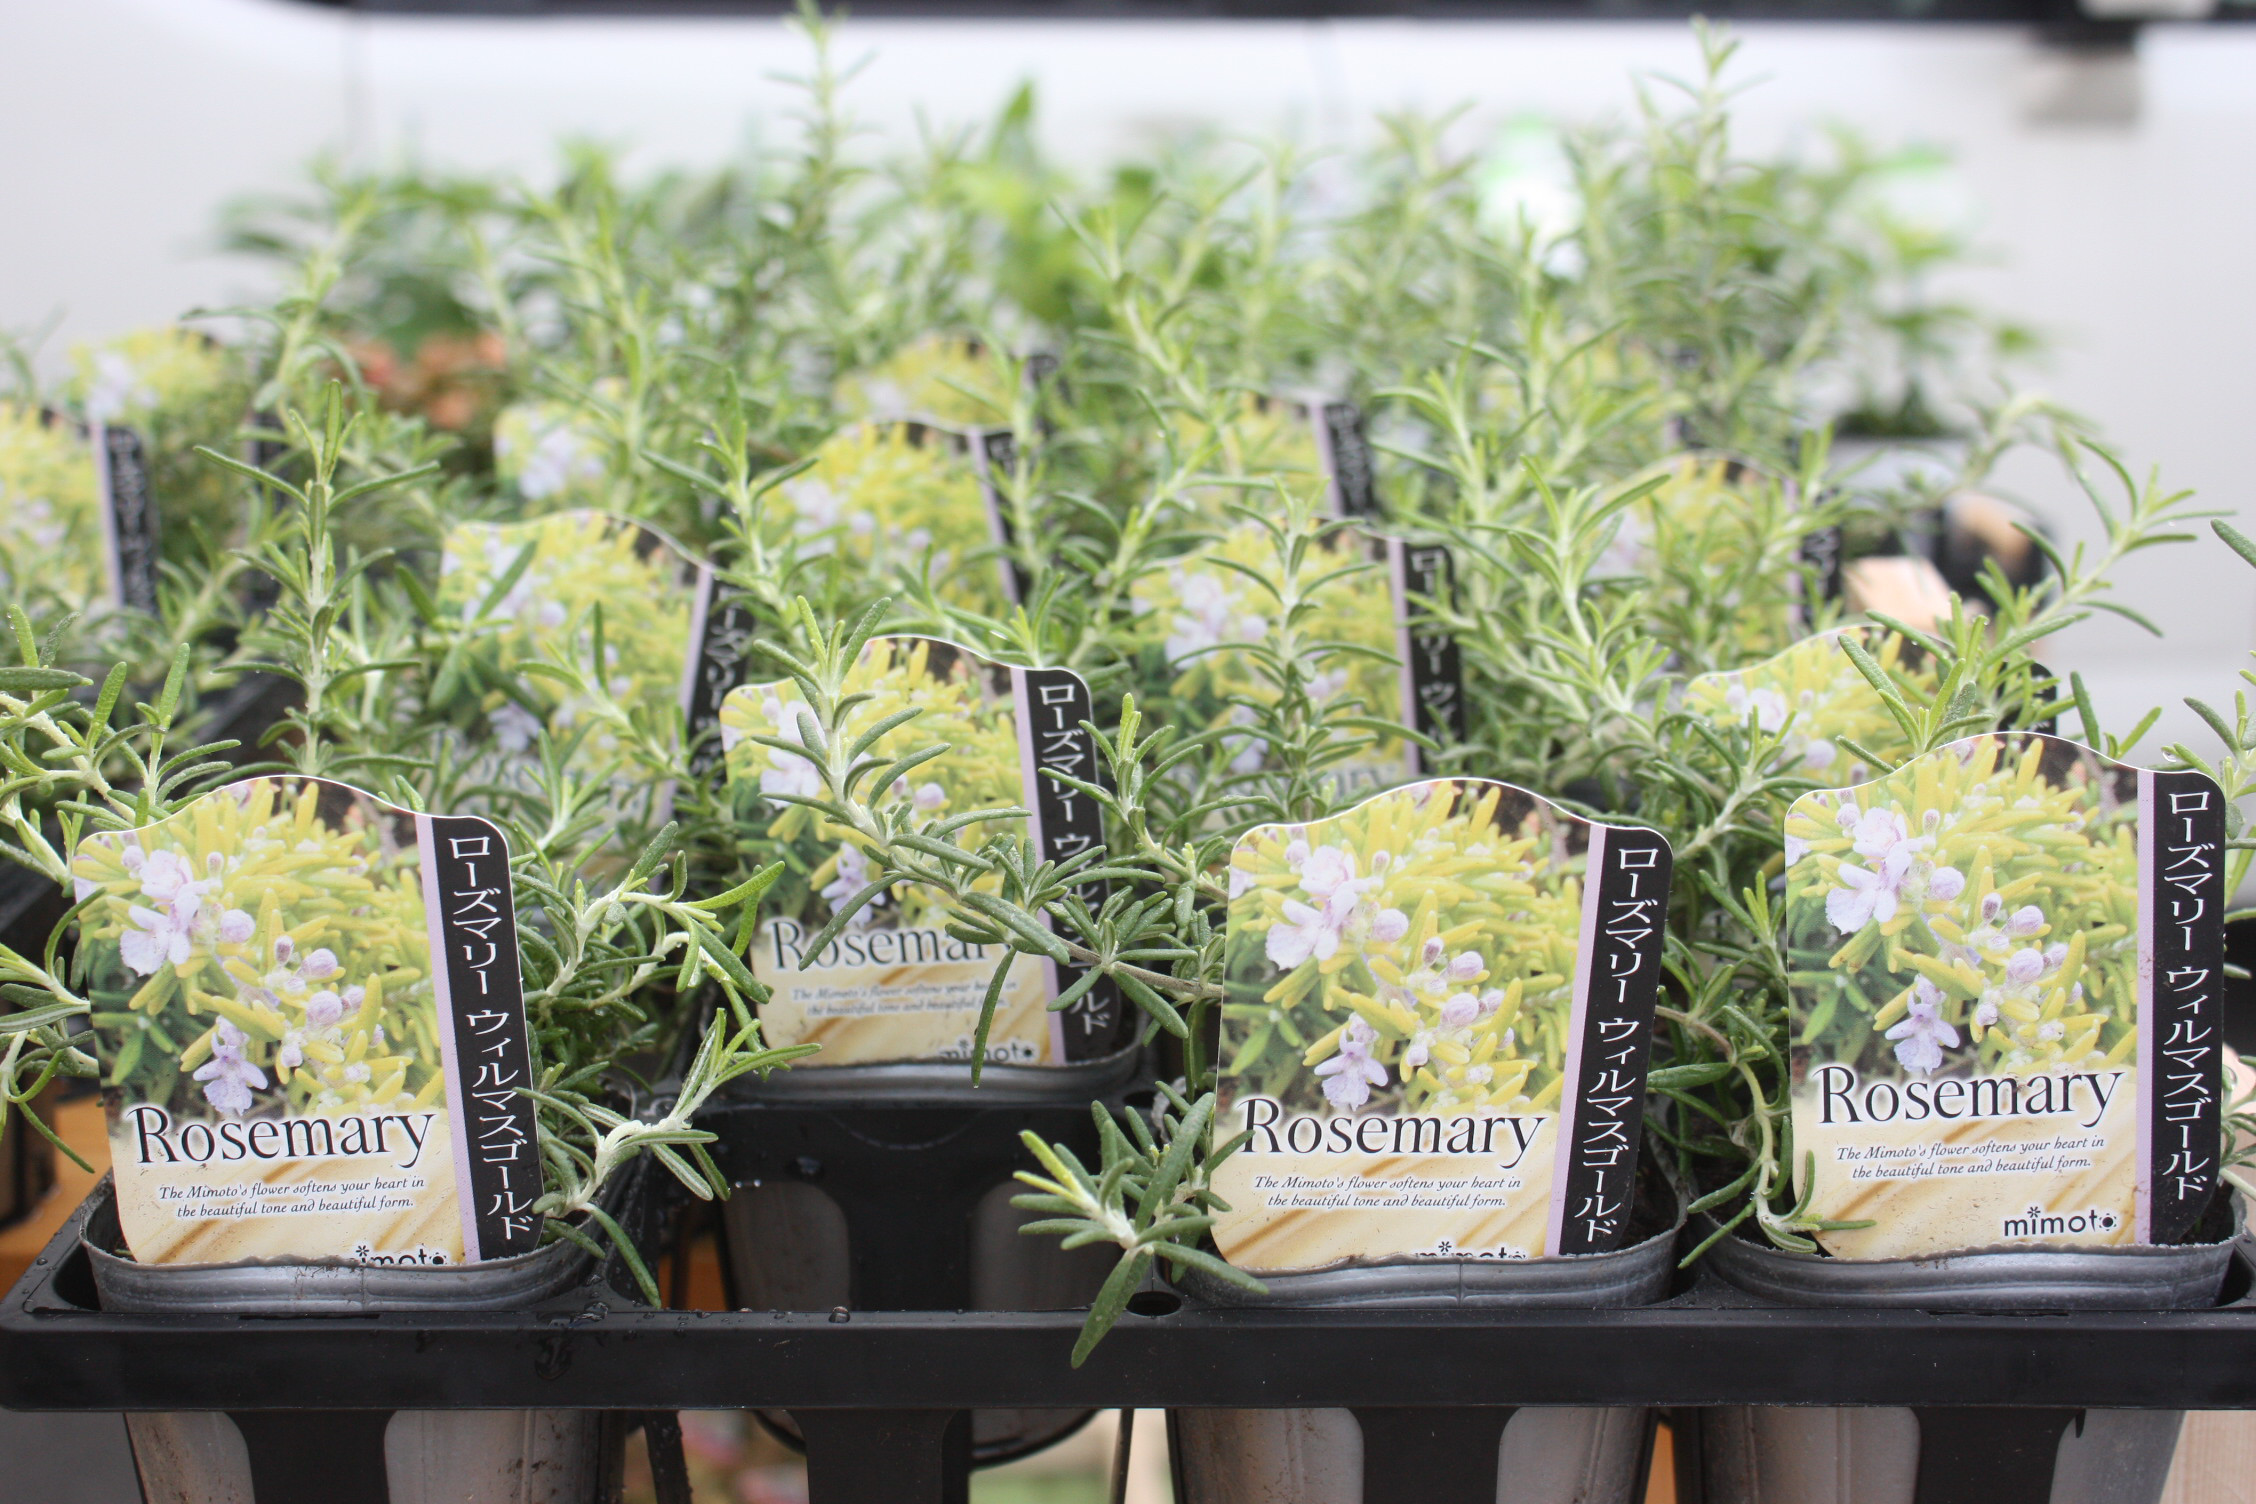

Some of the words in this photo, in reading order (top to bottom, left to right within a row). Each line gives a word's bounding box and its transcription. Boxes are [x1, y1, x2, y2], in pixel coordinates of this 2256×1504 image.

[2163, 789, 2215, 951] ローズマリー
[448, 836, 502, 995] ローズマリー
[770, 920, 1011, 970] Rosemar
[1604, 847, 1659, 1003] ローズマリー
[1812, 1065, 2125, 1128] Rosemary
[2161, 966, 2212, 1201] ウィルマスゴールド
[126, 1106, 436, 1168] Rosemary
[466, 1010, 534, 1240] ウィルマスゴールド
[1237, 1098, 1549, 1169] Rosemary
[1574, 1018, 1640, 1243] ウィルマスゴールド
[1837, 1147, 1861, 1160] The
[1864, 1145, 1926, 1159] Mimoto's
[1927, 1143, 1970, 1159] flower
[1972, 1140, 2016, 1156] softens
[2019, 1142, 2050, 1154] your
[2054, 1136, 2088, 1149] heart
[2091, 1135, 2104, 1147] in
[160, 1186, 183, 1199] The
[187, 1184, 248, 1198] Mimoto's
[249, 1182, 290, 1198] flower
[293, 1180, 336, 1196] softens
[340, 1182, 370, 1194] your
[374, 1177, 408, 1189] heart
[411, 1176, 424, 1187] in
[1254, 1176, 1279, 1188] The
[1281, 1176, 1344, 1188] Mimoto's
[1345, 1176, 1388, 1191] flower
[1389, 1176, 1434, 1191] softens
[1436, 1180, 1468, 1191] your
[1471, 1175, 1505, 1188] heart
[1508, 1176, 1521, 1188] in
[1852, 1165, 1871, 1178] the
[1875, 1162, 1935, 1179] beautiful
[1937, 1164, 1964, 1175] tone
[1967, 1159, 1993, 1173] and
[1995, 1155, 2054, 1173] beautiful
[2054, 1155, 2091, 1171] form.
[177, 1204, 196, 1217] the
[200, 1201, 257, 1218] beautiful
[261, 1204, 287, 1213] tone
[291, 1199, 315, 1212] and
[318, 1195, 376, 1212] beautiful
[378, 1195, 414, 1211] form.
[1267, 1194, 1288, 1206] the
[1291, 1194, 1351, 1209] beautiful
[1353, 1197, 1380, 1206] tone
[1382, 1194, 1409, 1206] and
[1411, 1194, 1470, 1209] beautiful
[1469, 1194, 1506, 1209] form.
